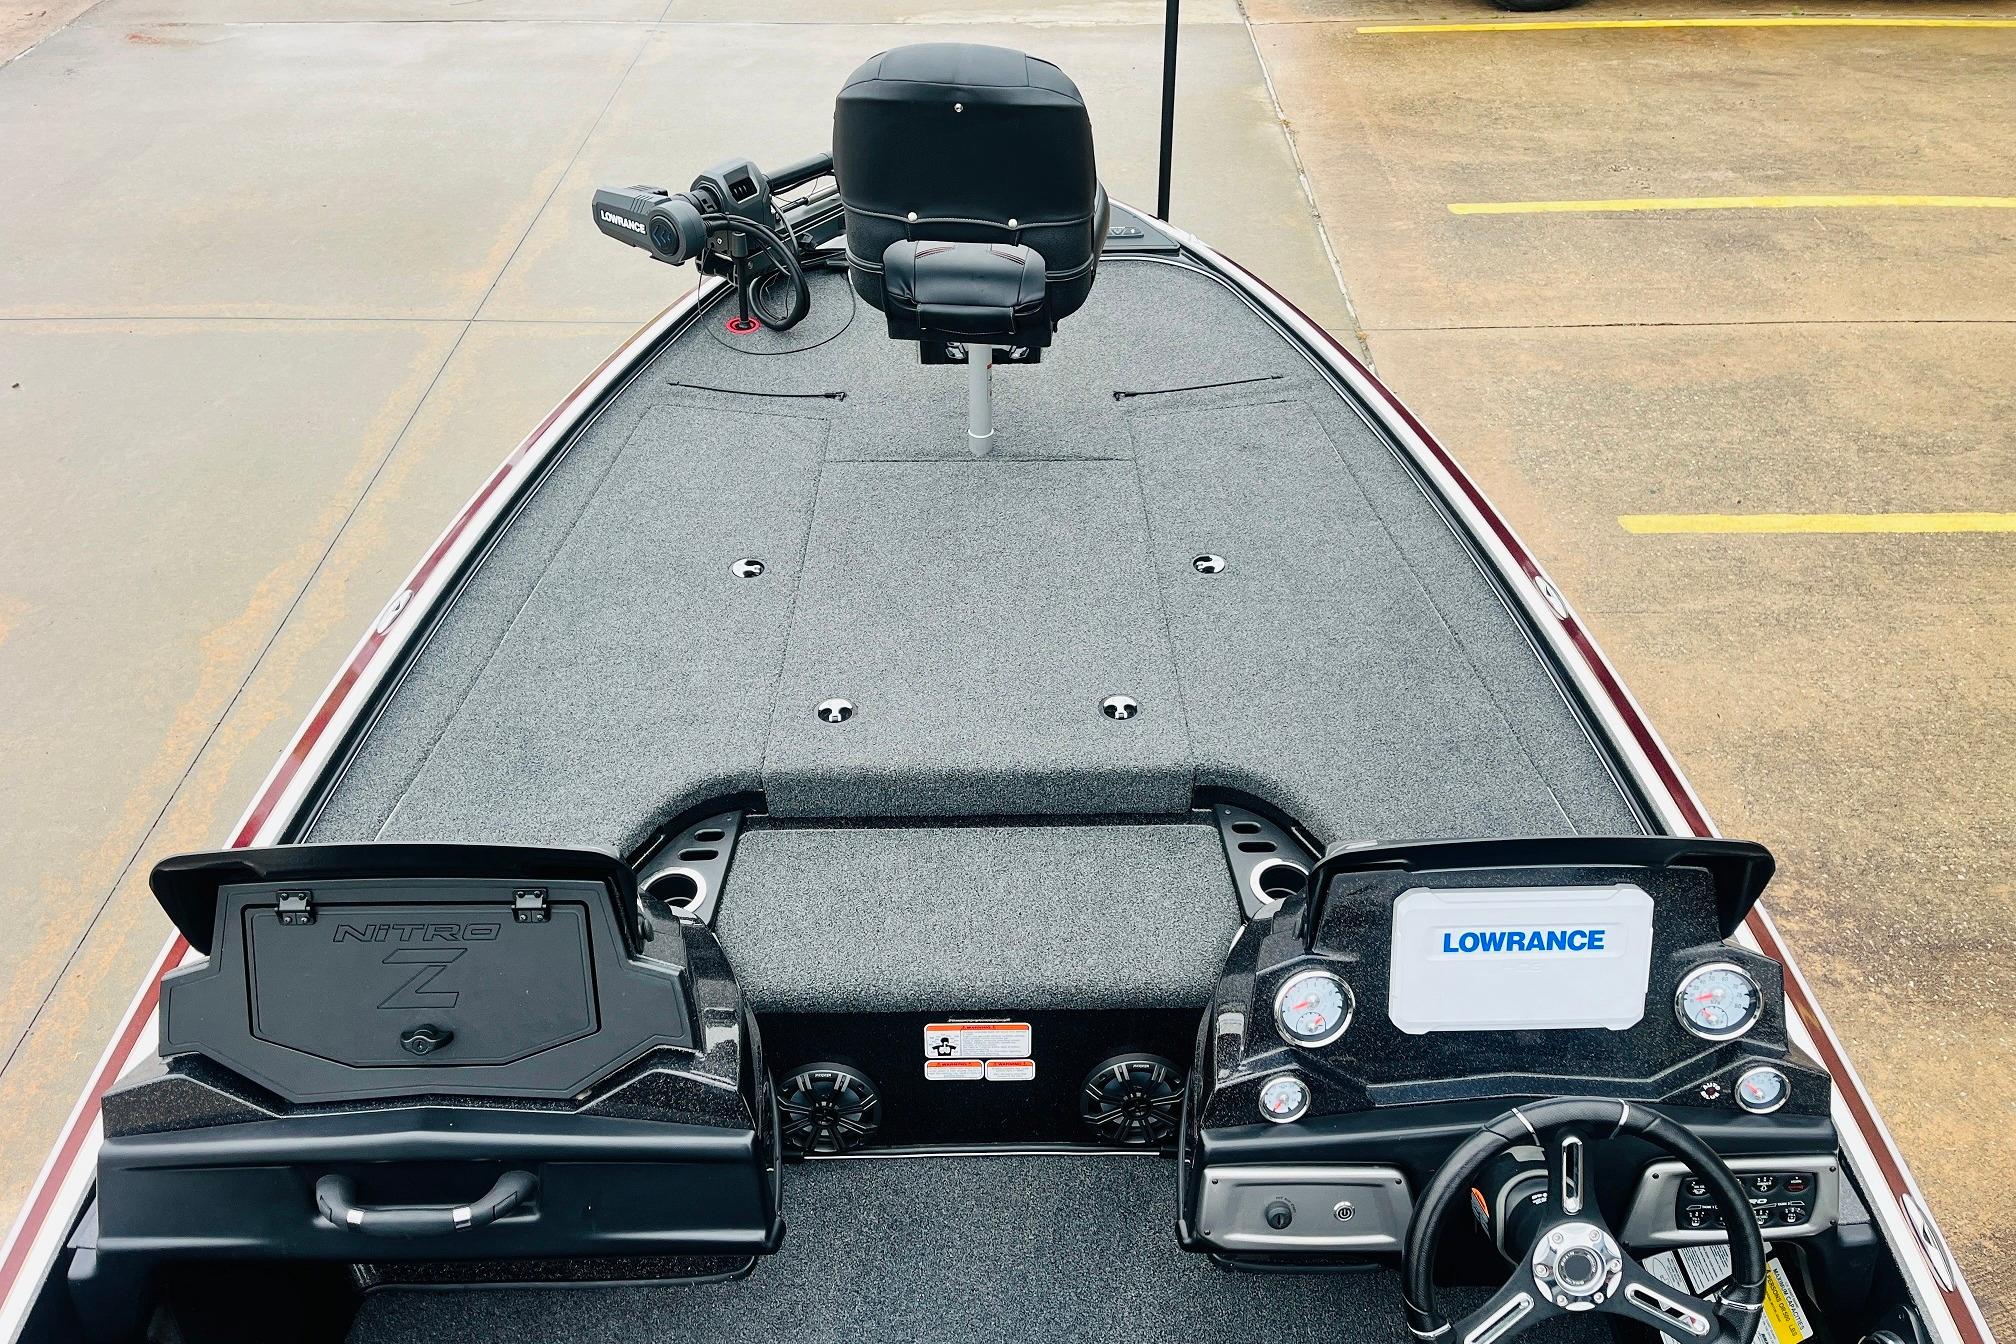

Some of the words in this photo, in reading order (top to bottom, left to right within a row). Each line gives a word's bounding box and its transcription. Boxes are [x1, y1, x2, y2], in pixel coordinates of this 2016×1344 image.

[600, 209, 646, 234] LOWRANCE
[1443, 929, 1606, 953] LOWRANCE
[377, 948, 468, 1009] Z
[1702, 1082, 1720, 1091] AUTO
